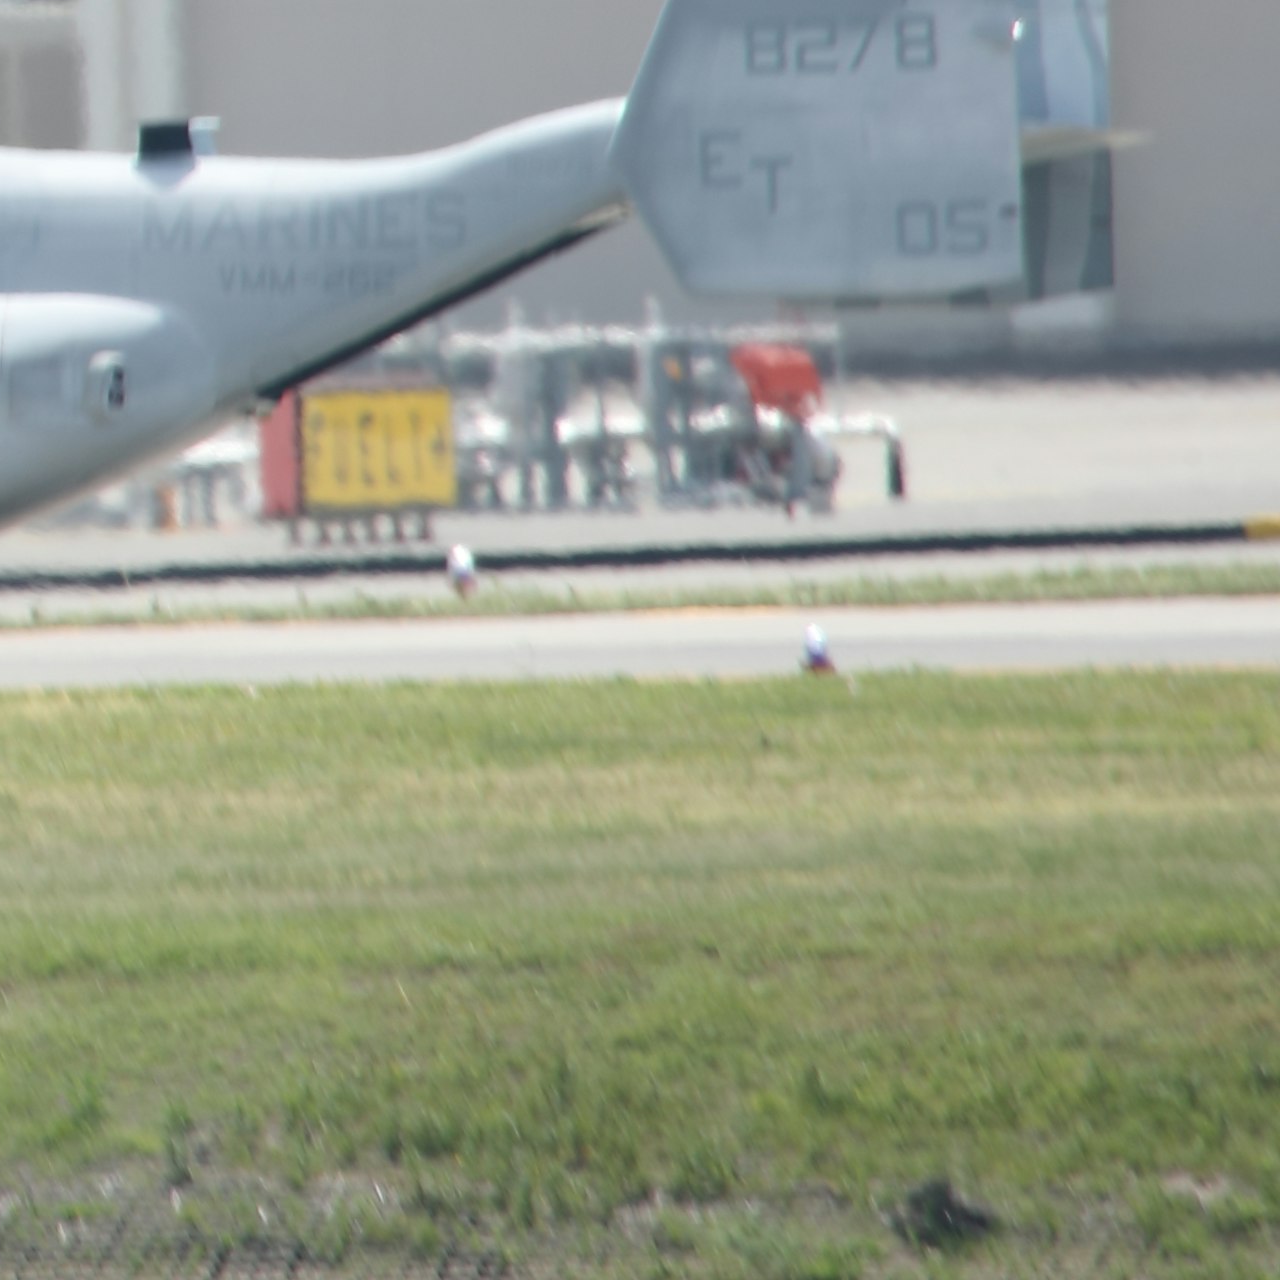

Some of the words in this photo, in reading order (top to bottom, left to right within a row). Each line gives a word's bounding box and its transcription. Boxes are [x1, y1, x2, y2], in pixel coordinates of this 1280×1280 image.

[743, 15, 936, 73] 8278
[142, 194, 468, 253] MARINES
[895, 199, 988, 257] 05
